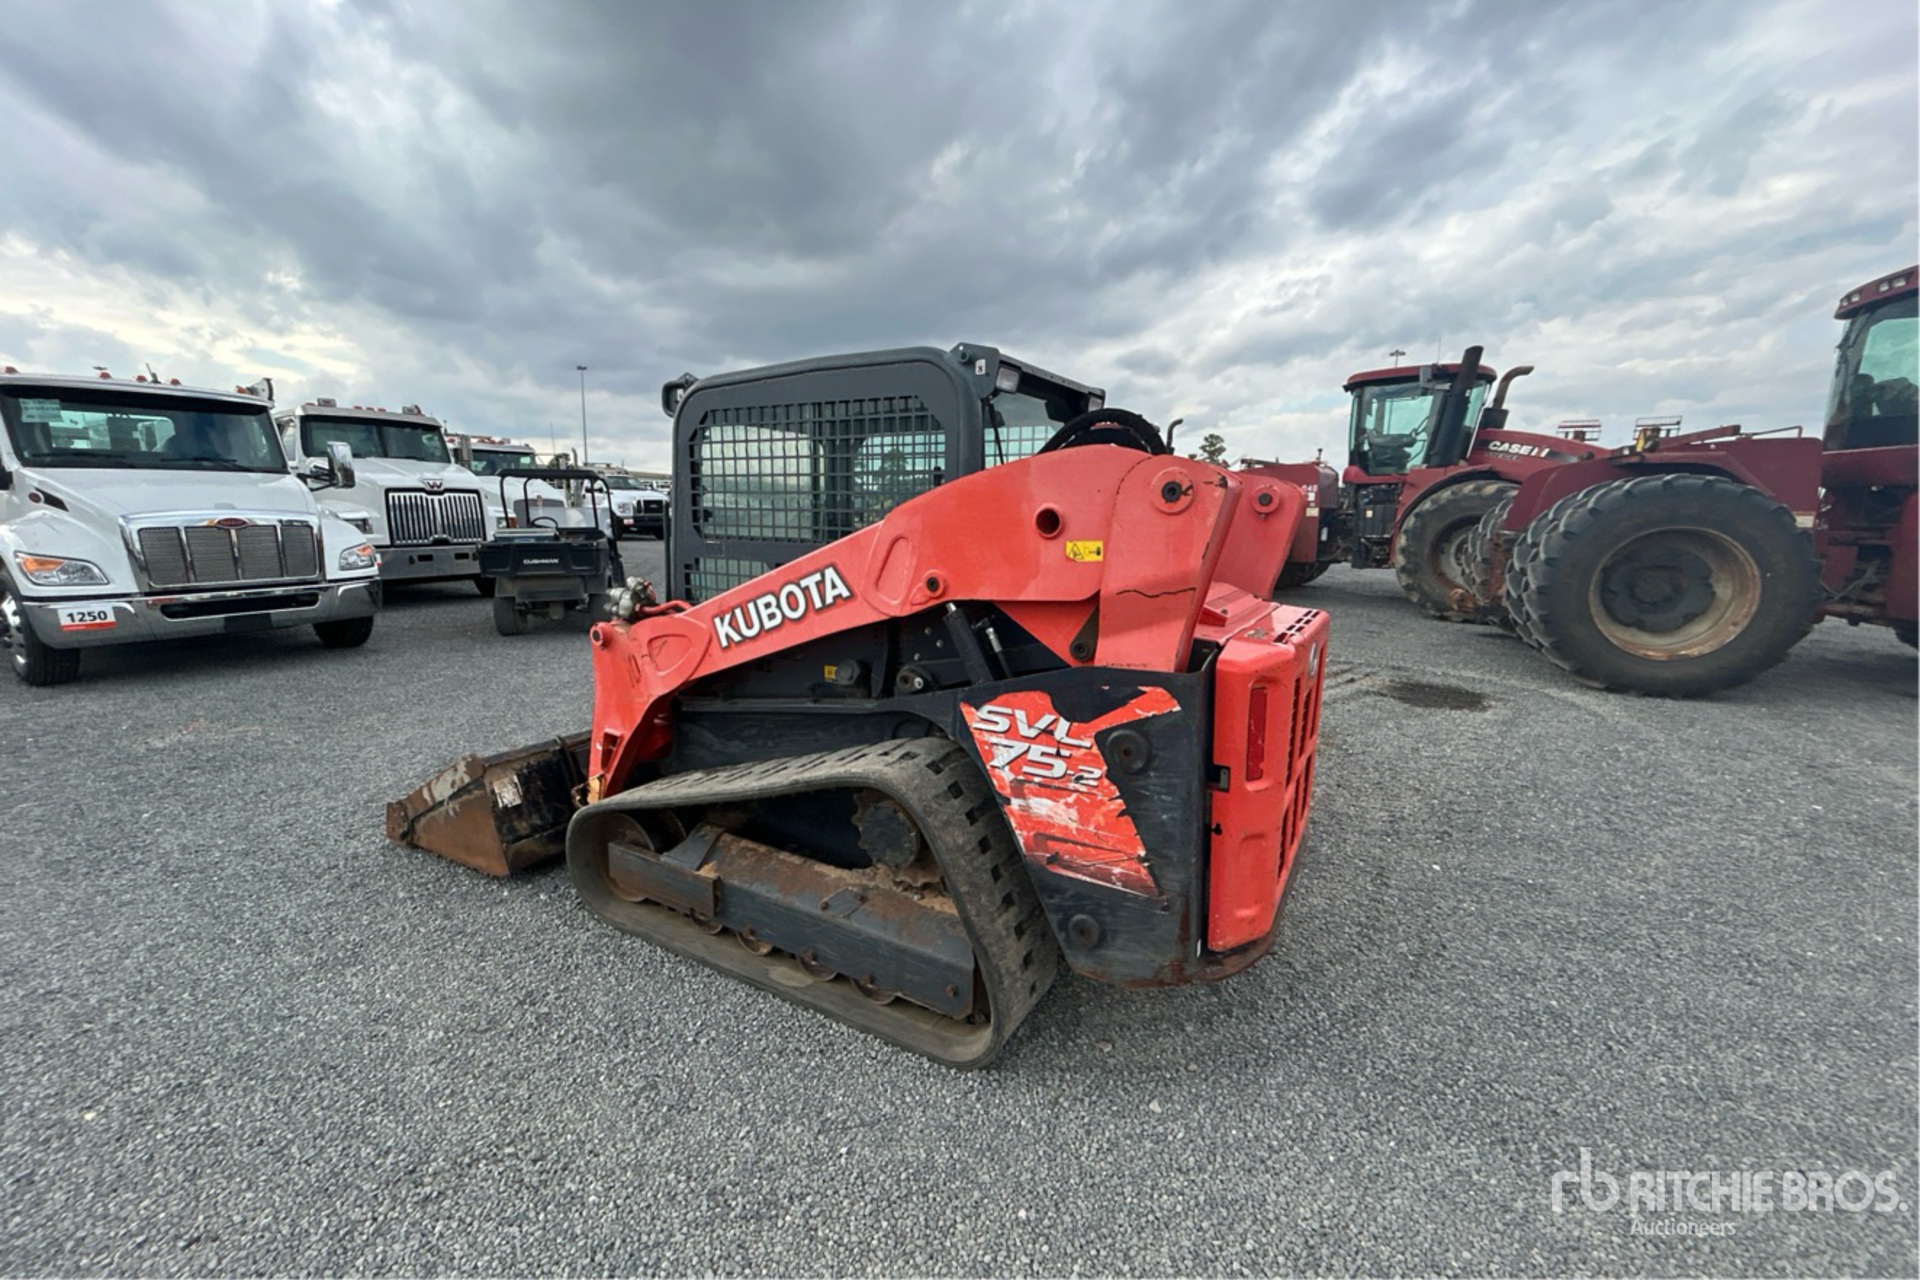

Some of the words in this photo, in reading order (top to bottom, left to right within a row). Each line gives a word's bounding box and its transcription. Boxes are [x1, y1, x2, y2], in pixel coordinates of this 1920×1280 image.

[1488, 440, 1533, 455] CASE
[67, 610, 108, 623] 1250
[713, 565, 852, 648] KUBOTA
[972, 704, 1093, 749] SVL
